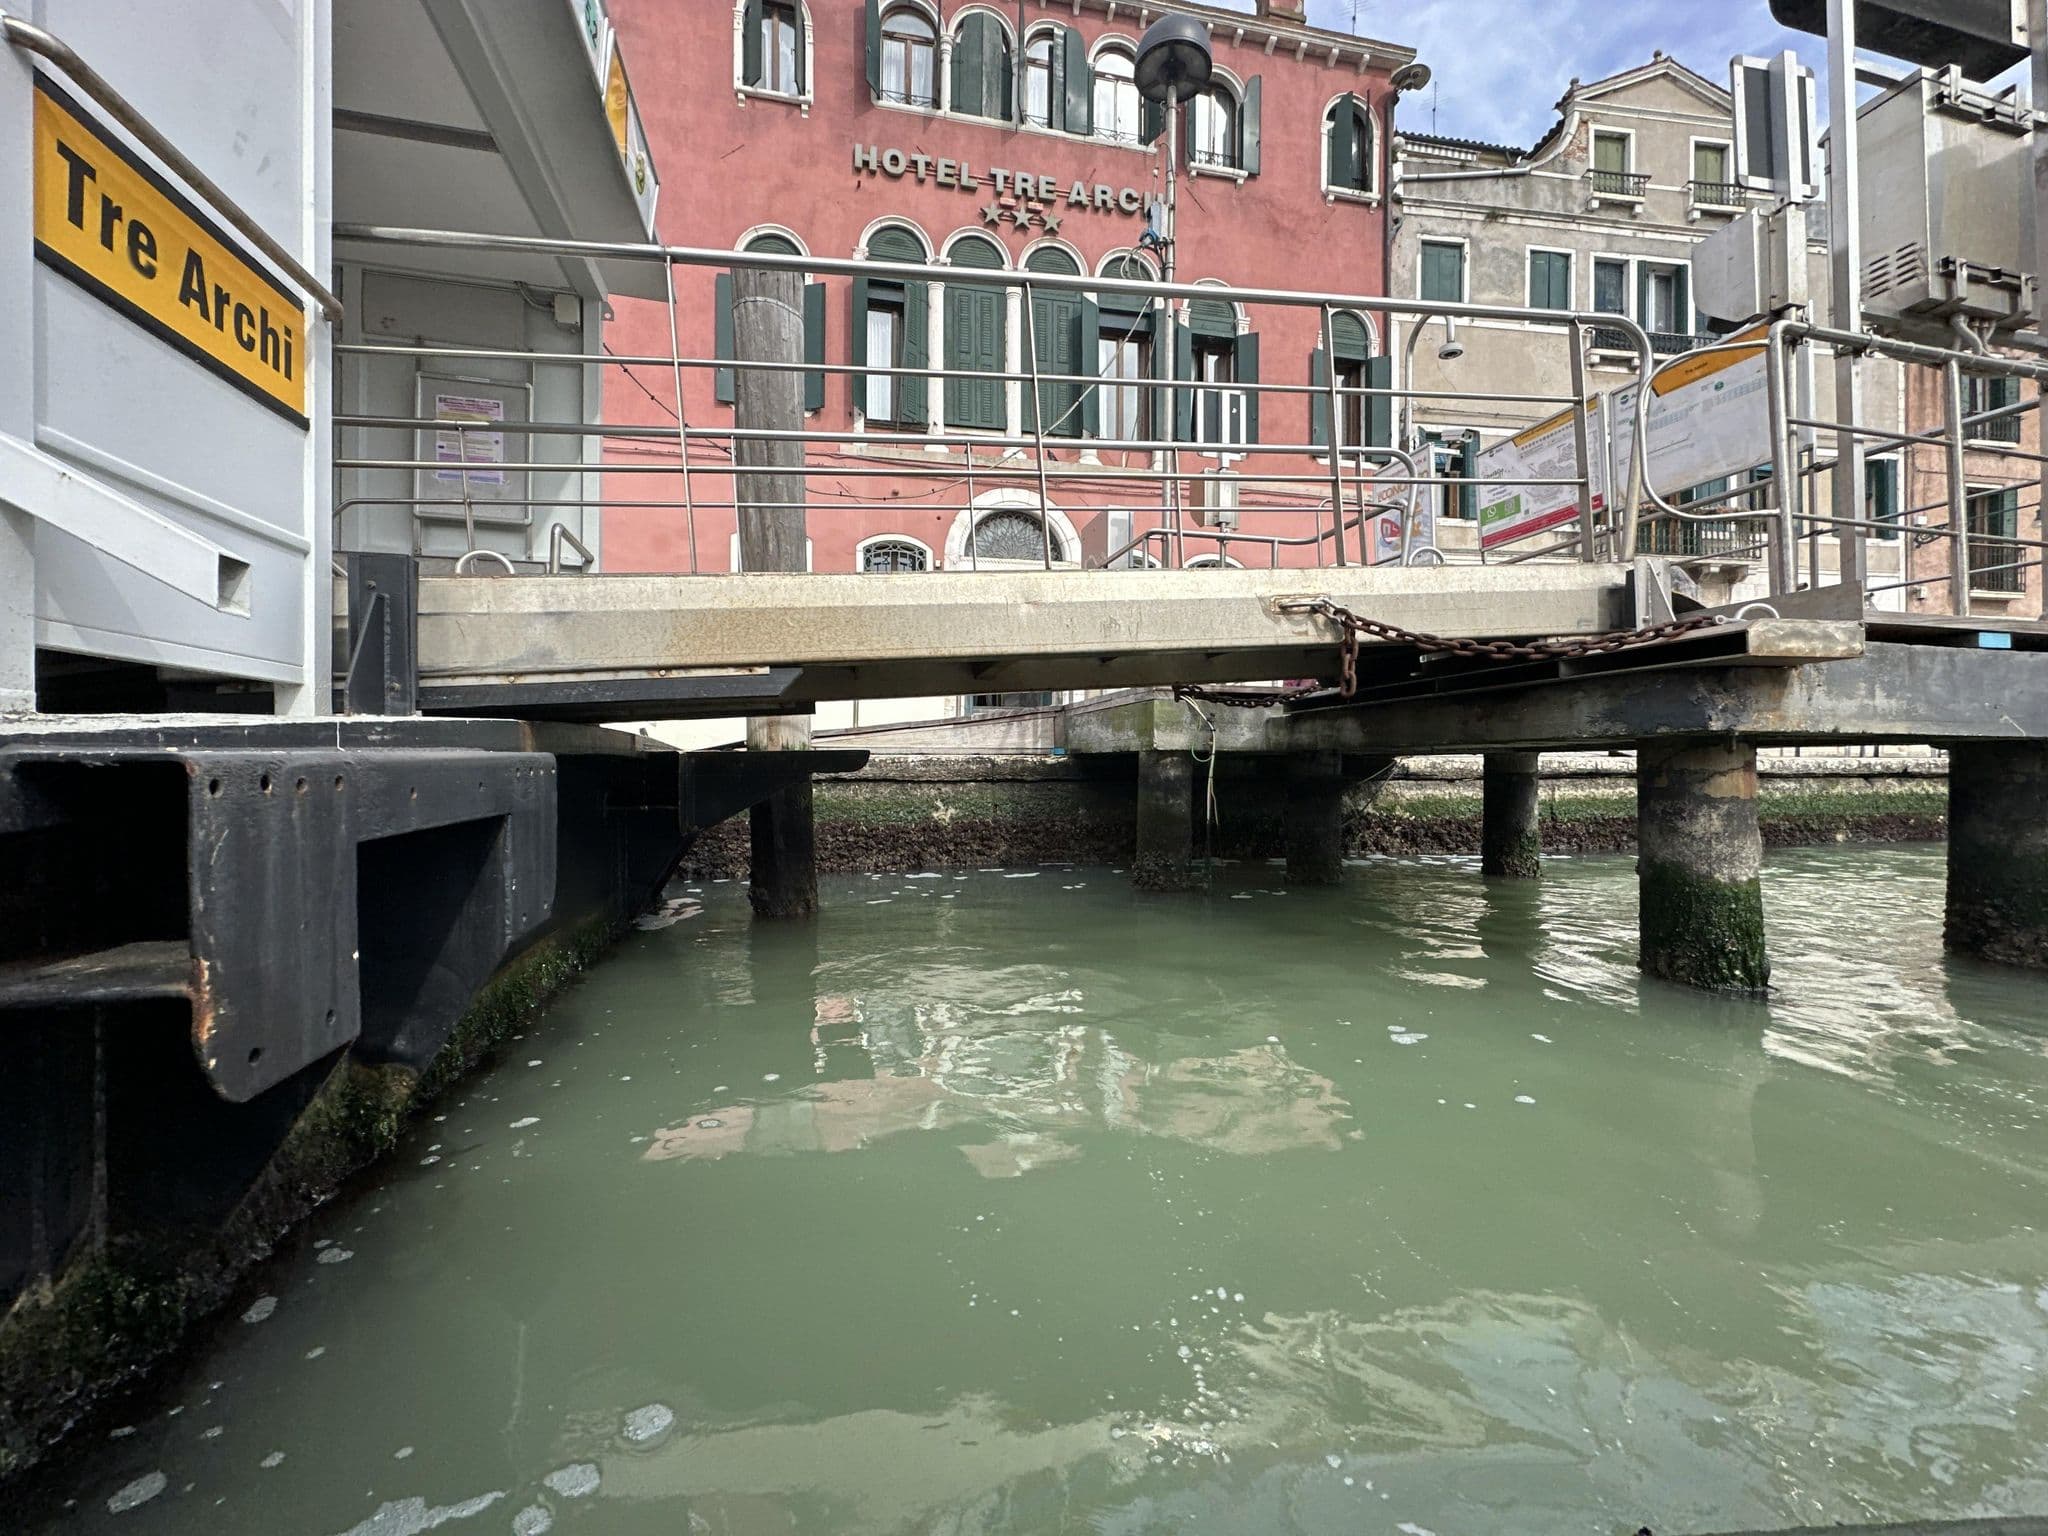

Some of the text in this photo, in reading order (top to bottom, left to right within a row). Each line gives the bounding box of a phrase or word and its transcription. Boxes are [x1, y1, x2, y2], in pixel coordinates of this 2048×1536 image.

[854, 143, 978, 190] HOTEL
[990, 167, 1057, 202] TRE
[56, 138, 293, 382] Tre Archi
